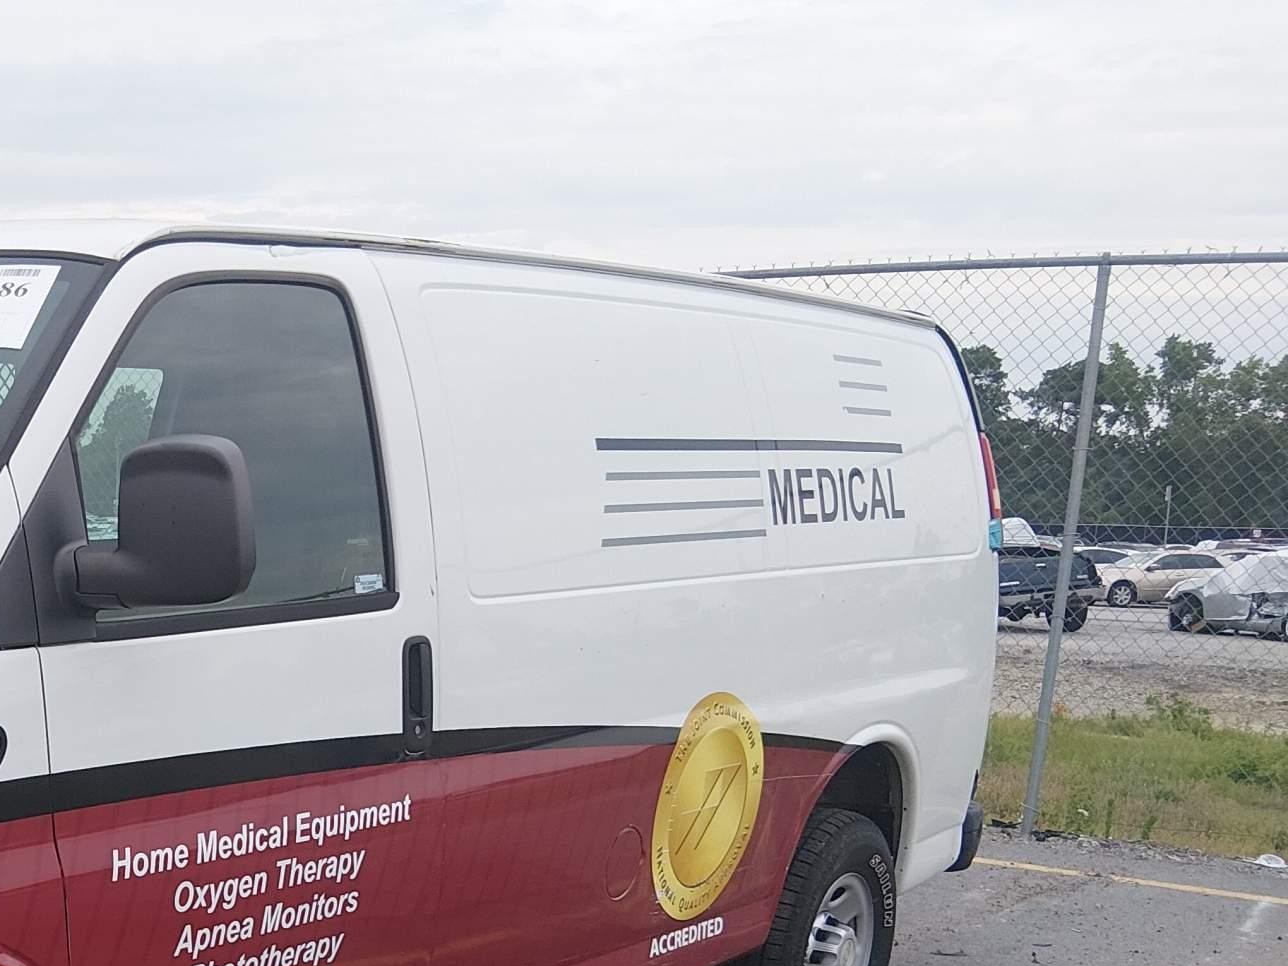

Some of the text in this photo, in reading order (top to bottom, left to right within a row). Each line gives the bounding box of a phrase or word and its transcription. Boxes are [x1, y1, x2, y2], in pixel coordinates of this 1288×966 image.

[767, 467, 906, 526] MEDICAL
[713, 701, 756, 750] COMMISSION
[111, 793, 412, 882] Home Medical Equipment
[174, 849, 366, 914] Oxygen Therapy
[656, 845, 677, 906] NATIONAL
[869, 853, 894, 927] SAILUN
[173, 890, 360, 960] Apnea Monitors
[649, 916, 724, 959] ACCREDITED
